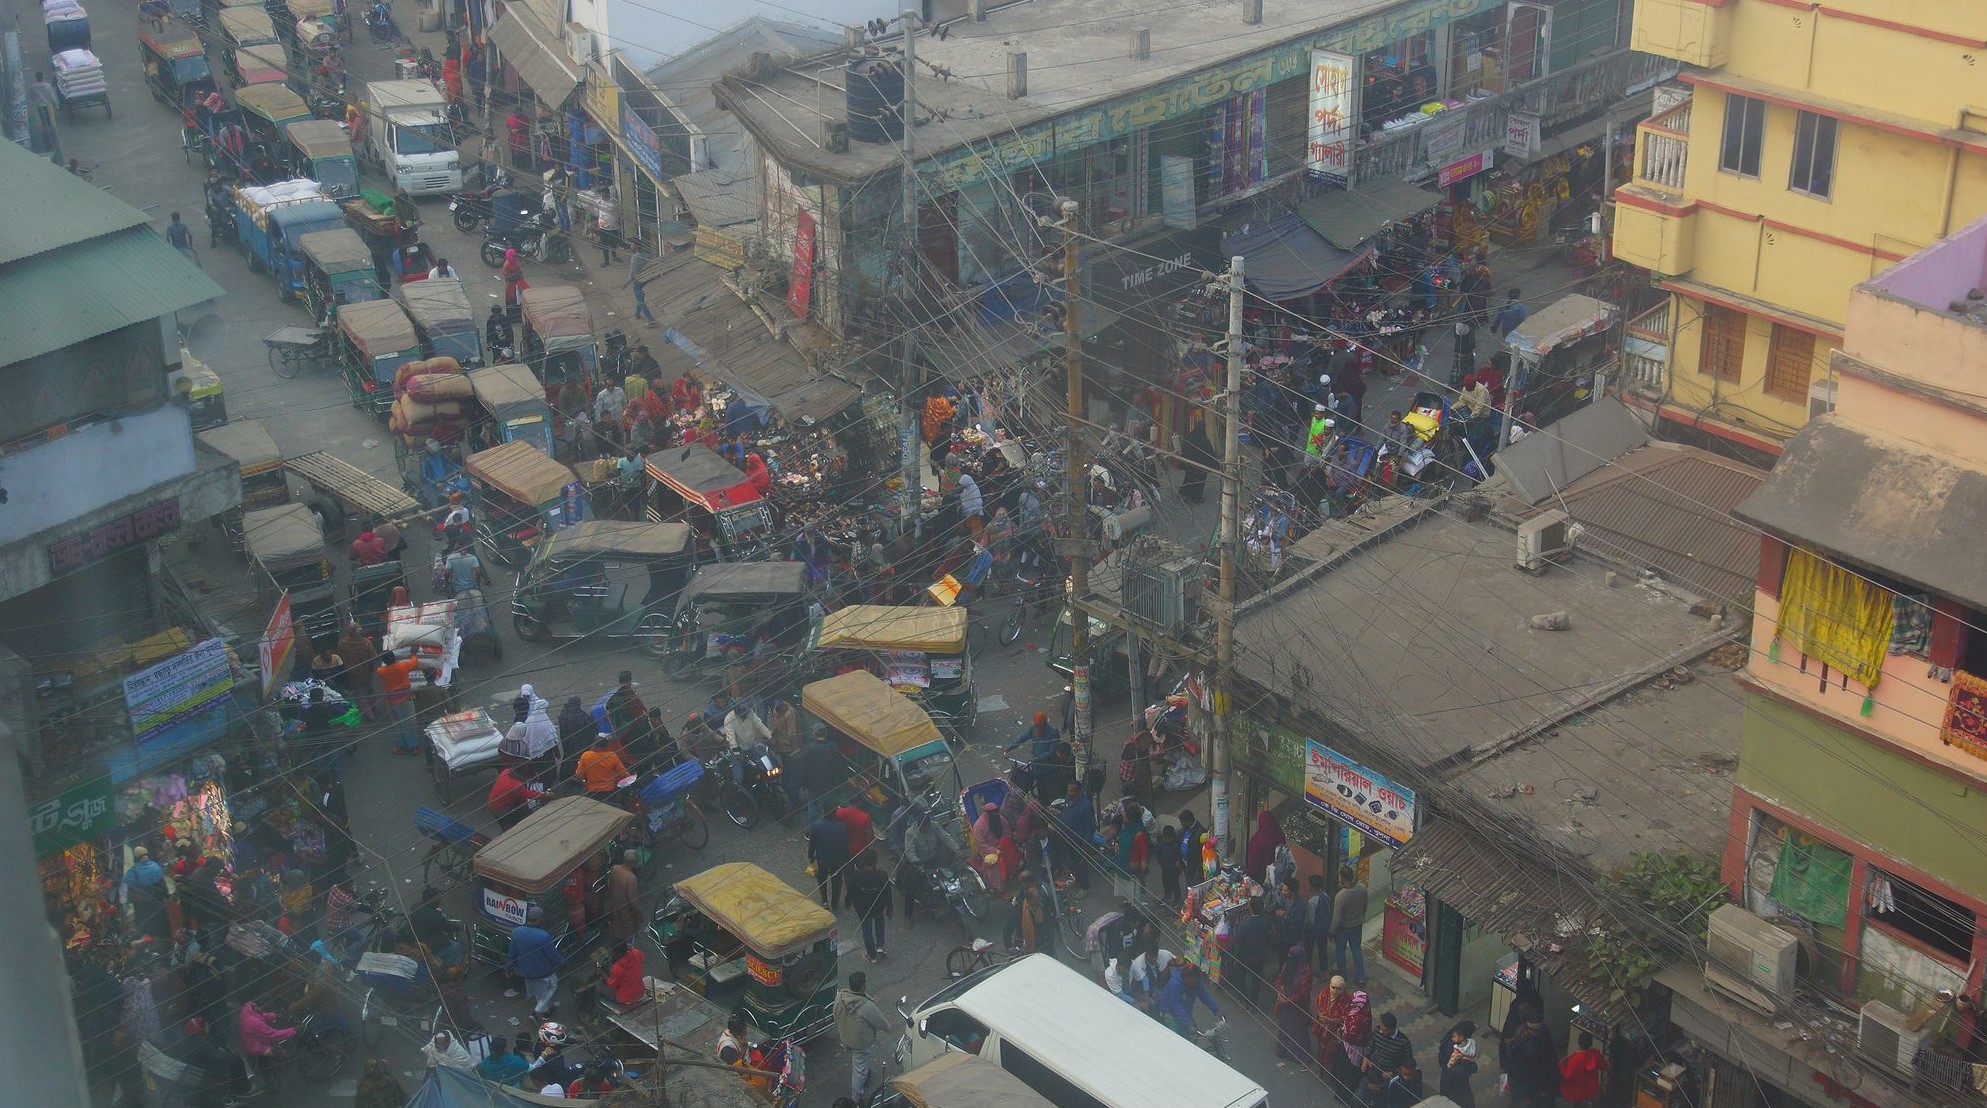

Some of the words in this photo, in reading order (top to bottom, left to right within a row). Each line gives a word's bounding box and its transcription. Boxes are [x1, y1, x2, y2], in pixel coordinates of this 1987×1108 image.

[1314, 105, 1343, 137] পর্দা
[1508, 128, 1528, 144] পর্দা
[1121, 268, 1154, 290] TIME
[1157, 252, 1192, 277] ZONE
[1377, 786, 1406, 811] ওয়াচ
[486, 896, 525, 917] RAINBOW
